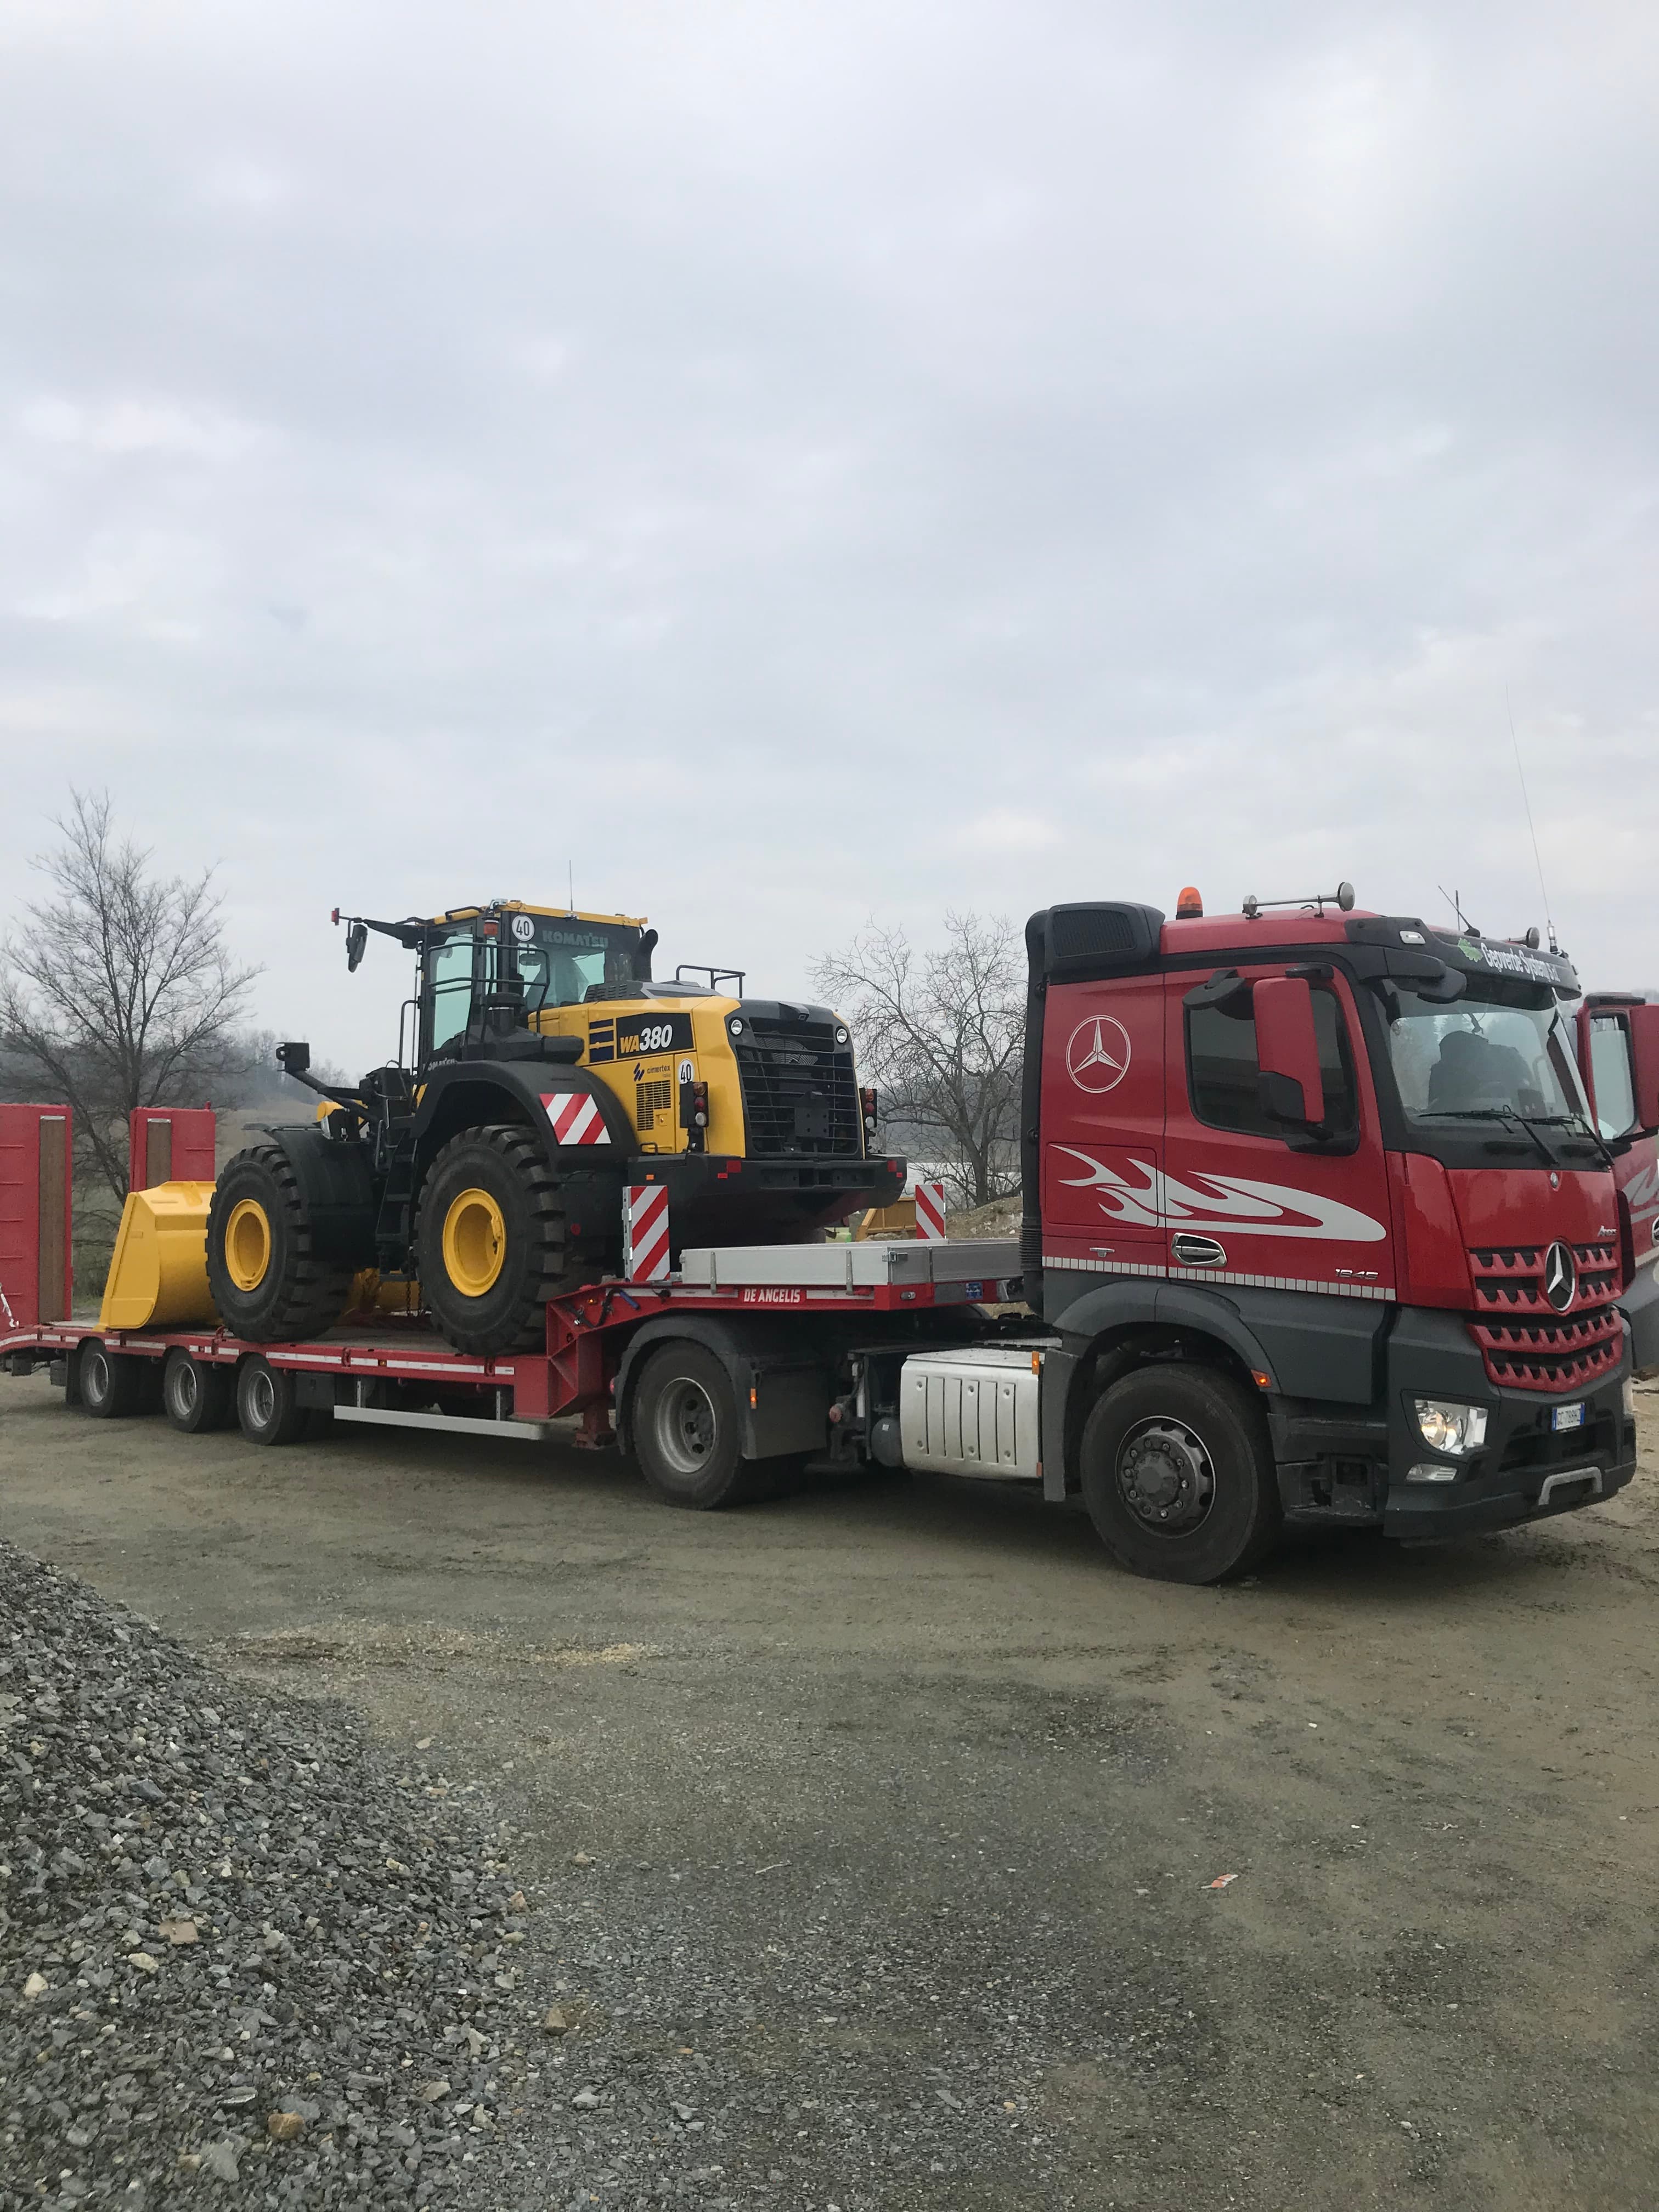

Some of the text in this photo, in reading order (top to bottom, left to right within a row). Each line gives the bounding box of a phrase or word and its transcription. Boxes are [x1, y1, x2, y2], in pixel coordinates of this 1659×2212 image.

[516, 919, 529, 936] 40
[542, 930, 608, 949] KOMATSU
[620, 1024, 673, 1054] WA380
[680, 1064, 691, 1082] 40
[744, 1288, 801, 1303] DE ANGELIS
